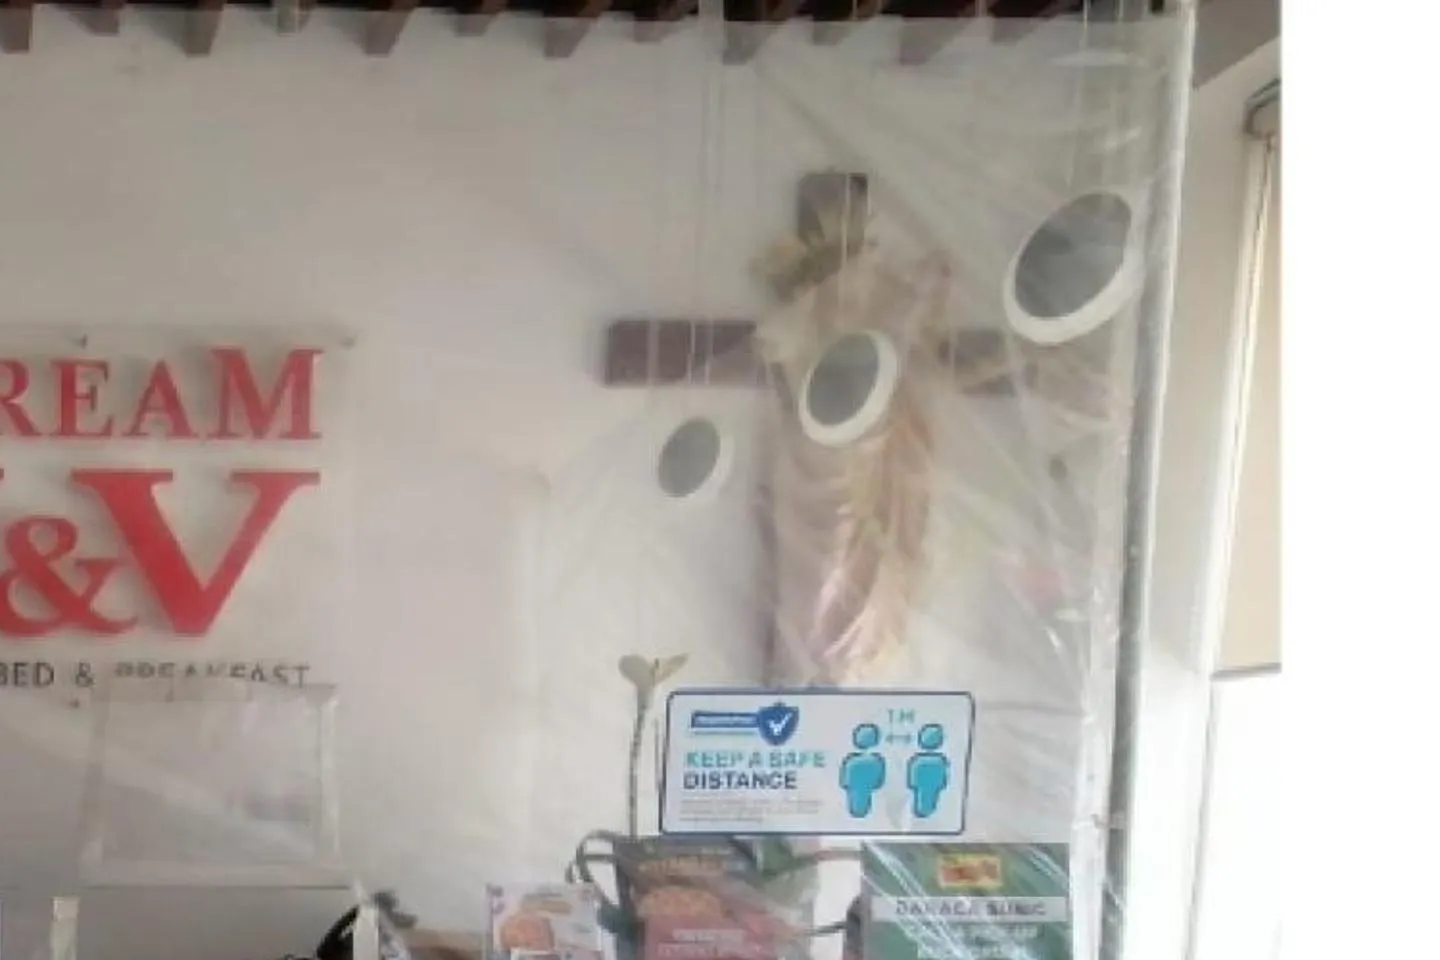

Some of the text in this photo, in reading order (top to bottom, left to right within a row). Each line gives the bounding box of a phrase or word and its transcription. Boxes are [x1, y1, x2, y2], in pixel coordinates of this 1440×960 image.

[73, 661, 96, 688] &
[686, 751, 827, 769] KEEP A SAFE
[682, 770, 799, 790] DISTANCE
